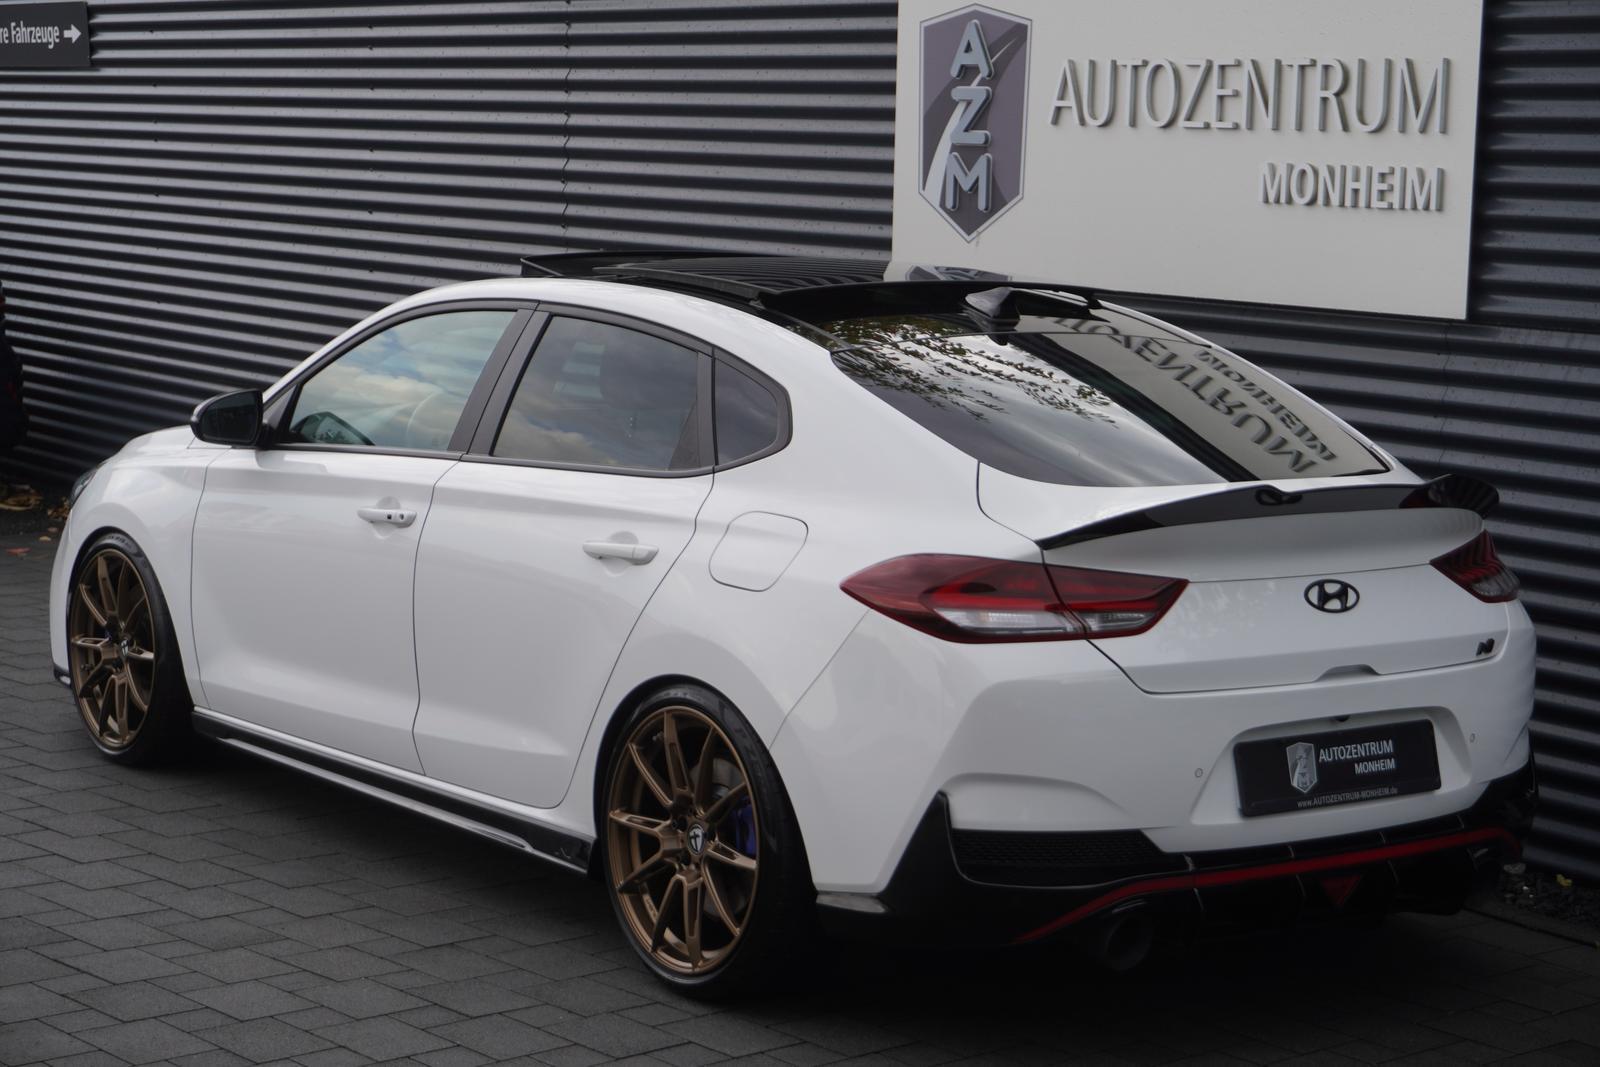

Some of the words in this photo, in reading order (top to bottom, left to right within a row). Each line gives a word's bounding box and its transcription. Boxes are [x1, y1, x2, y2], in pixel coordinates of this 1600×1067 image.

[11, 20, 60, 49] Fahrzeuge
[1046, 57, 1450, 135] AUTOZENTRUM
[1260, 162, 1446, 212] MONHEIM
[1319, 739, 1394, 763] AUTOZENTRUM
[1354, 758, 1396, 775] MONHEIM
